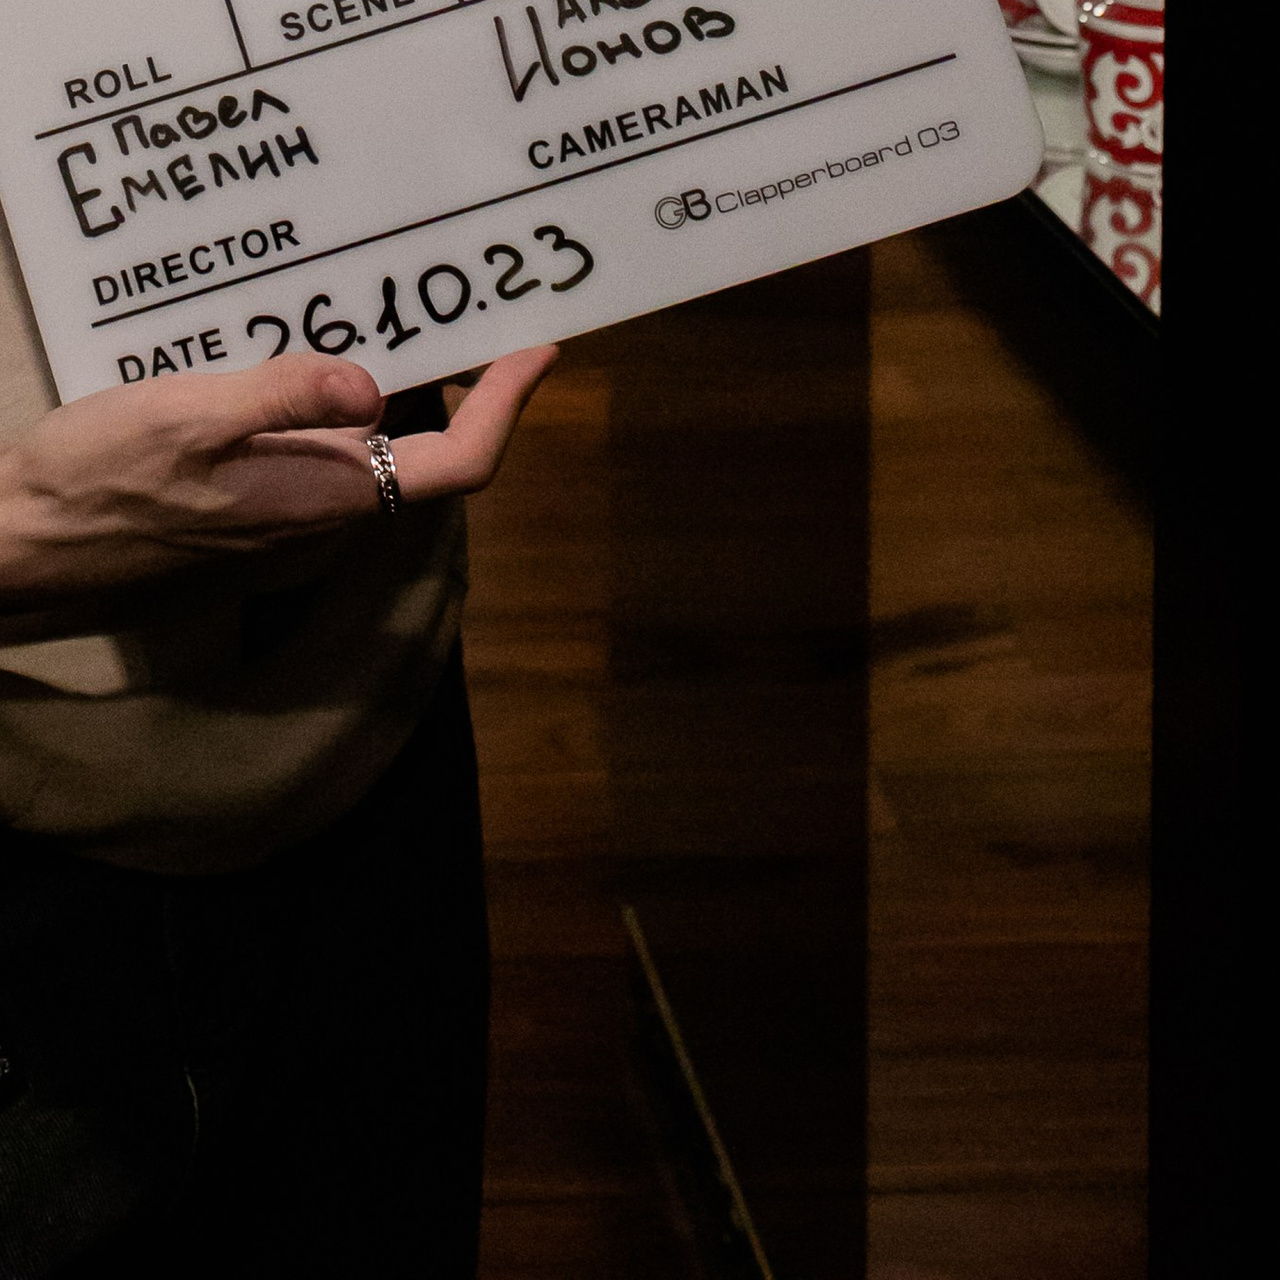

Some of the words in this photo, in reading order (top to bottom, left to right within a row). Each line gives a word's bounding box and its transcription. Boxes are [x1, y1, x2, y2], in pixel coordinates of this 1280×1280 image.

[64, 57, 172, 109] ROLL
[528, 65, 789, 169] CAMERAMAN
[112, 89, 290, 156] Павел
[715, 136, 912, 213] Clapperboard
[92, 220, 300, 306] DIRECTOR
[246, 224, 595, 359] 26.10.23
[117, 328, 227, 384] DATE
